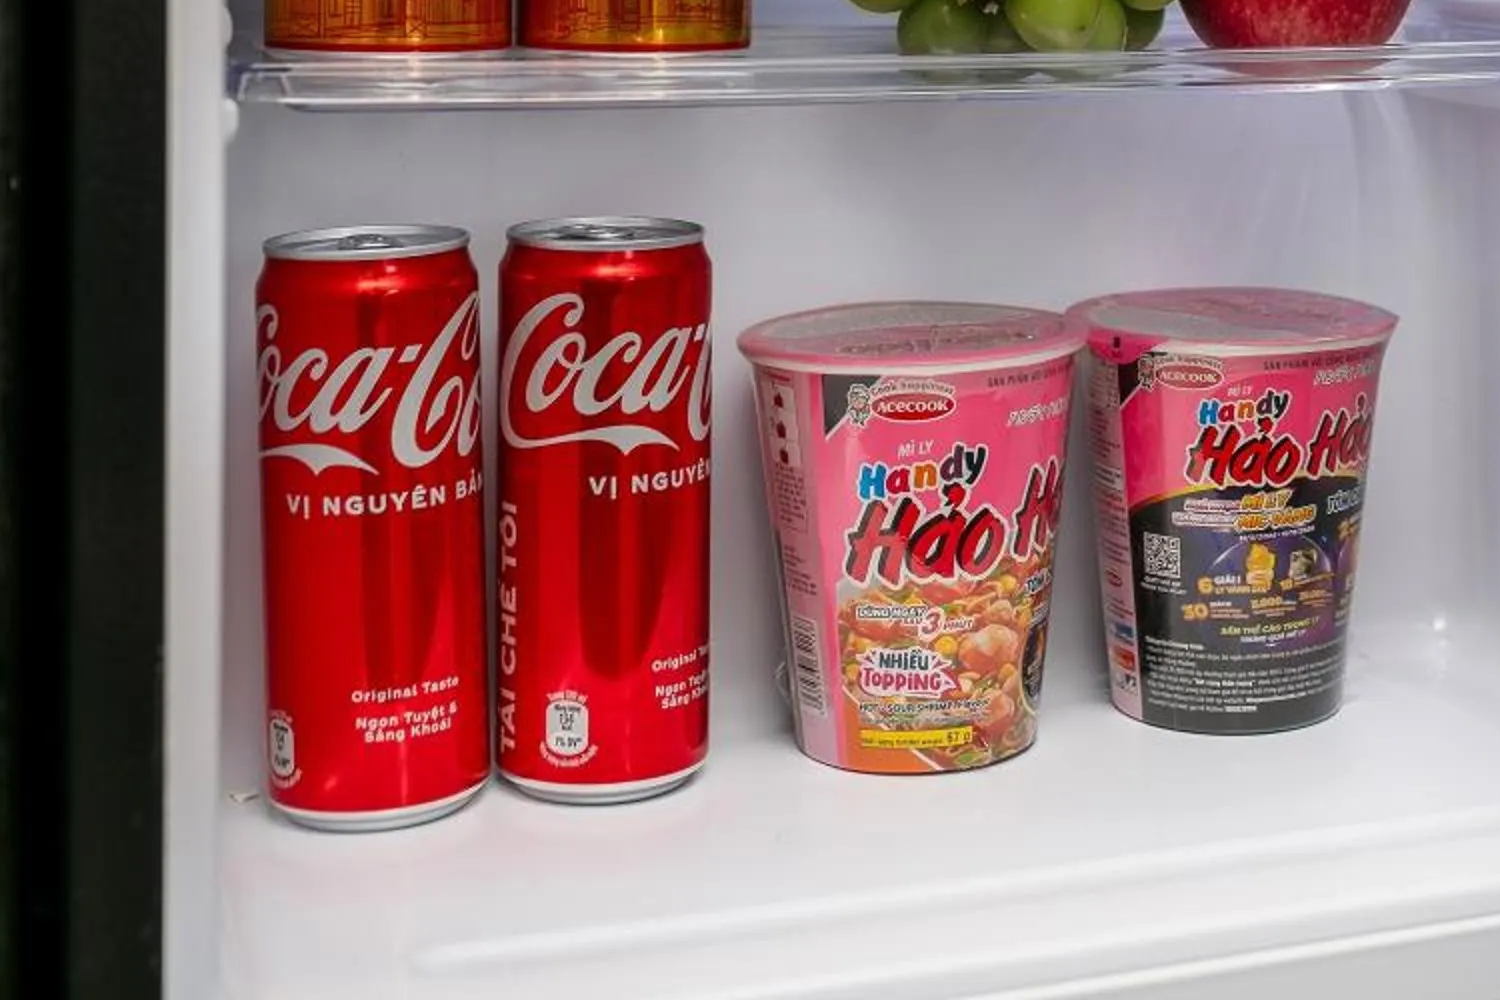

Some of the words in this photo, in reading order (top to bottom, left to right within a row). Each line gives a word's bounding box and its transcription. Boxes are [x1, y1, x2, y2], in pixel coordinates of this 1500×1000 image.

[1198, 390, 1291, 427] Handy
[1185, 416, 1302, 488] Hảo
[1306, 392, 1373, 479] Hả
[590, 475, 618, 500] VỊ
[859, 442, 987, 500] Handy
[286, 492, 311, 520] VỊ
[322, 478, 446, 517] NGUYÊN
[845, 482, 1008, 589] Hảo
[921, 611, 941, 636] 3
[351, 683, 418, 703] Original
[422, 676, 459, 694] Taste
[355, 716, 399, 731] Ngon
